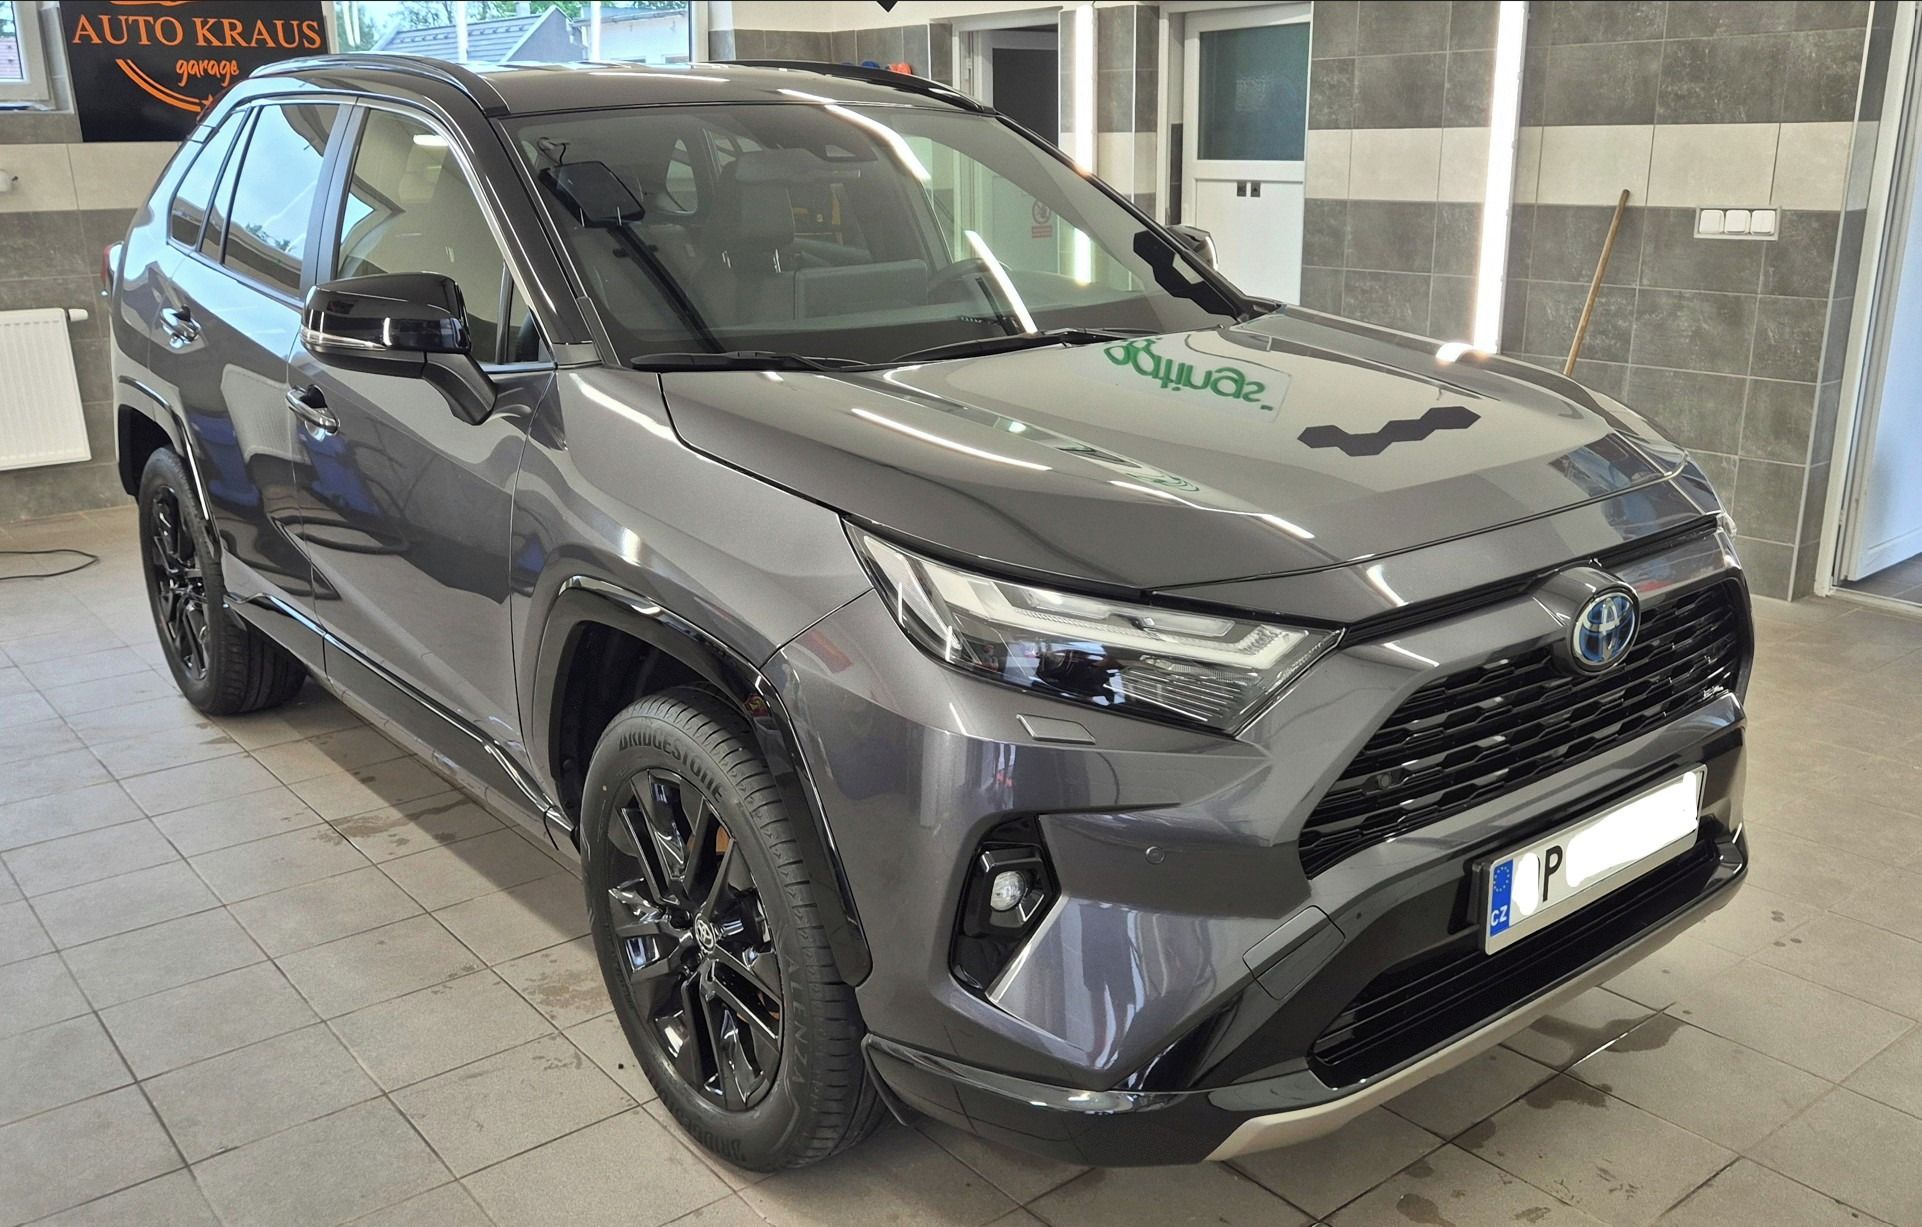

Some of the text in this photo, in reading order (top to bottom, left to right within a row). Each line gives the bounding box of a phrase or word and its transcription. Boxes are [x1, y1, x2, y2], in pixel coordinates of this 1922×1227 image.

[73, 15, 322, 48] AUTO KRAUS
[176, 57, 240, 87] garage
[619, 731, 723, 803] BRIDGESTONE
[1491, 905, 1508, 927] CZ
[784, 954, 809, 1084] ALENZA
